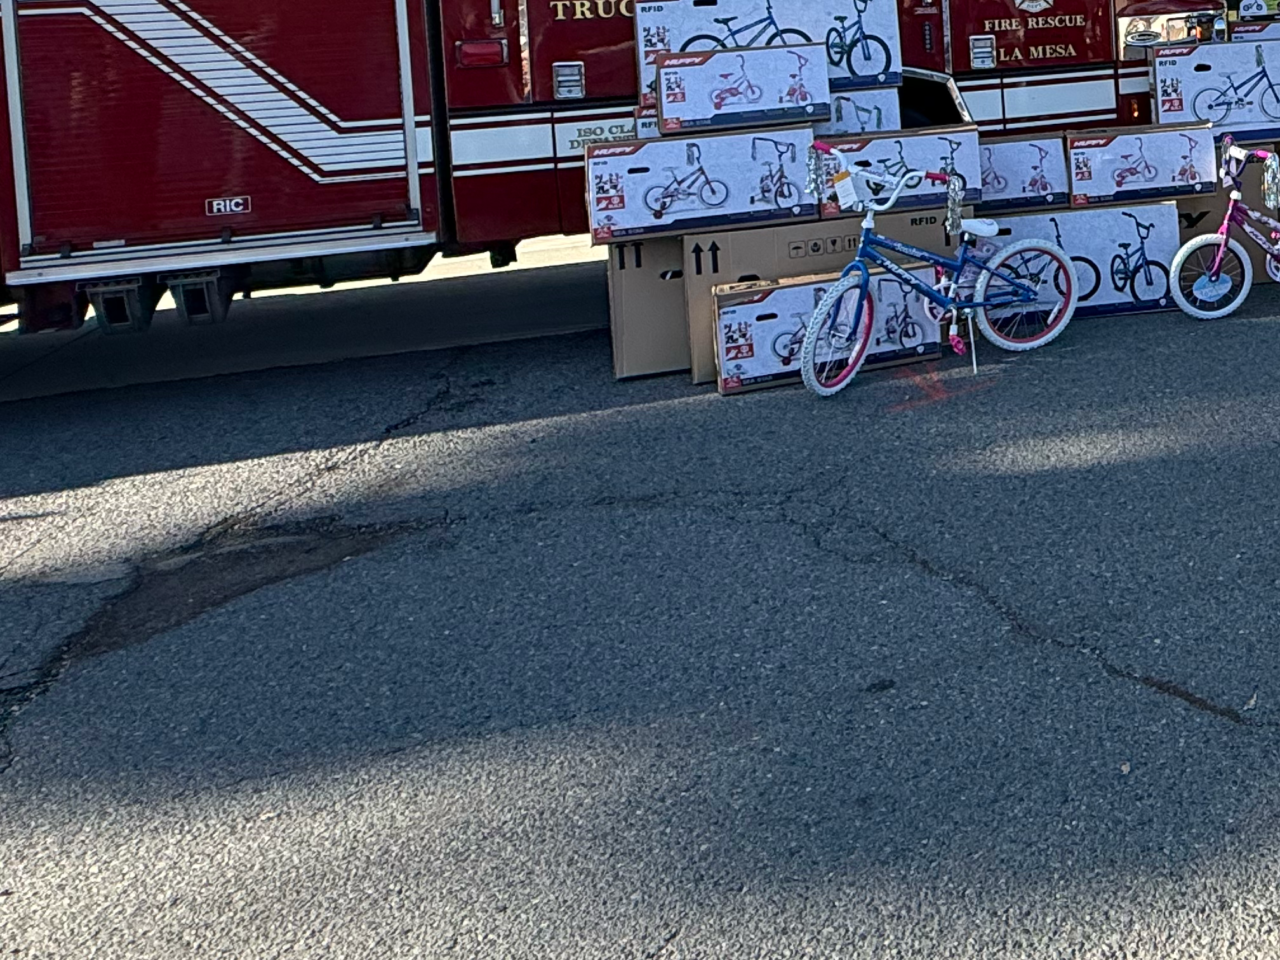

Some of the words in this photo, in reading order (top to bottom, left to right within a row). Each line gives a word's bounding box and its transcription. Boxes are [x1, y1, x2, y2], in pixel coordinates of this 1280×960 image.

[640, 5, 664, 13] RFID
[984, 19, 1021, 32] FIRE
[1028, 15, 1086, 29] RESCUE
[1234, 25, 1263, 33] HUFFY
[1000, 48, 1023, 61] LA
[1029, 44, 1077, 59] MESA
[1158, 47, 1190, 56] HUFFY
[664, 57, 704, 66] HUFFY
[576, 126, 605, 138] ISO
[1073, 139, 1107, 148] HUFFY
[593, 146, 635, 156] HUFFY
[213, 199, 243, 213] RIC
[910, 216, 937, 226] RFID
[882, 258, 920, 284] HUFFY
